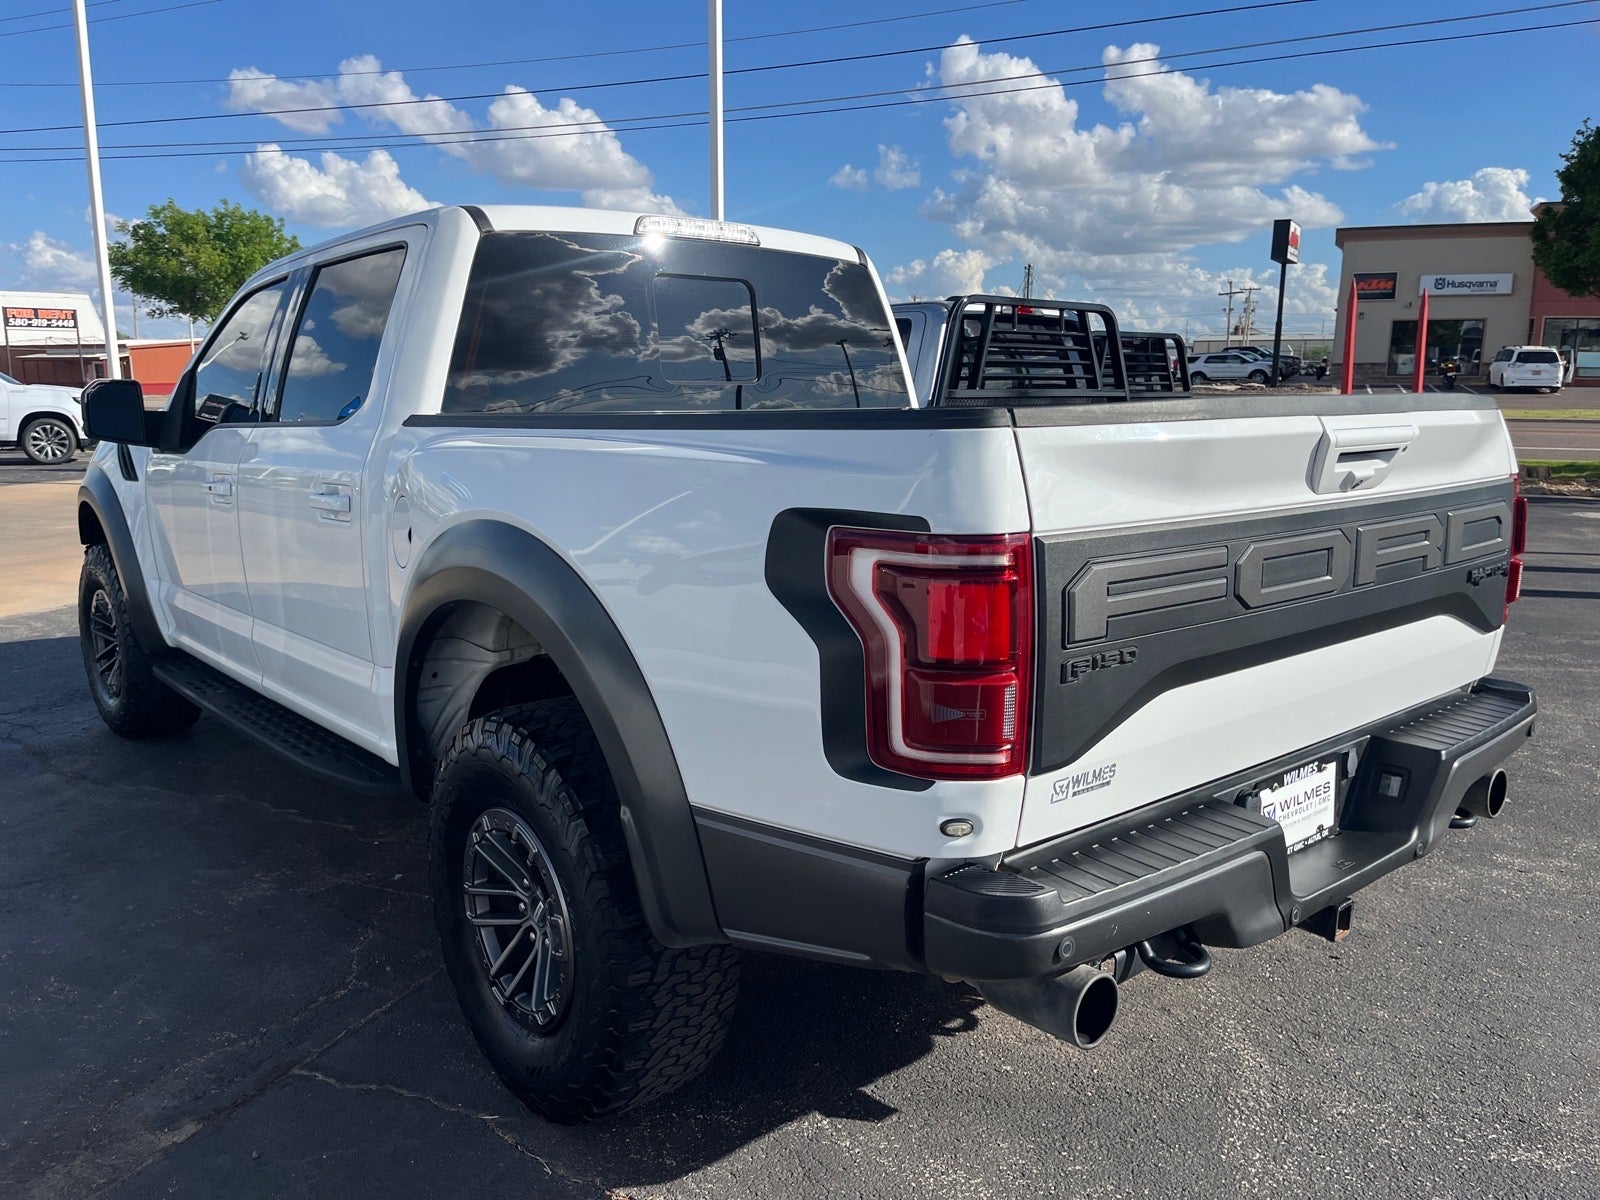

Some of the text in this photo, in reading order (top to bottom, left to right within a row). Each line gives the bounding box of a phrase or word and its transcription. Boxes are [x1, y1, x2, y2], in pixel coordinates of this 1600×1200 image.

[1357, 280, 1394, 290] KTM
[1446, 279, 1498, 290] Husqvarna
[6, 308, 74, 320] FOR RENT
[1062, 499, 1512, 648] FORD
[1071, 763, 1117, 790] WILMES
[1283, 761, 1319, 787] WILMES
[1279, 781, 1331, 812] WILMES
[1278, 801, 1313, 823] CHEVROLET
